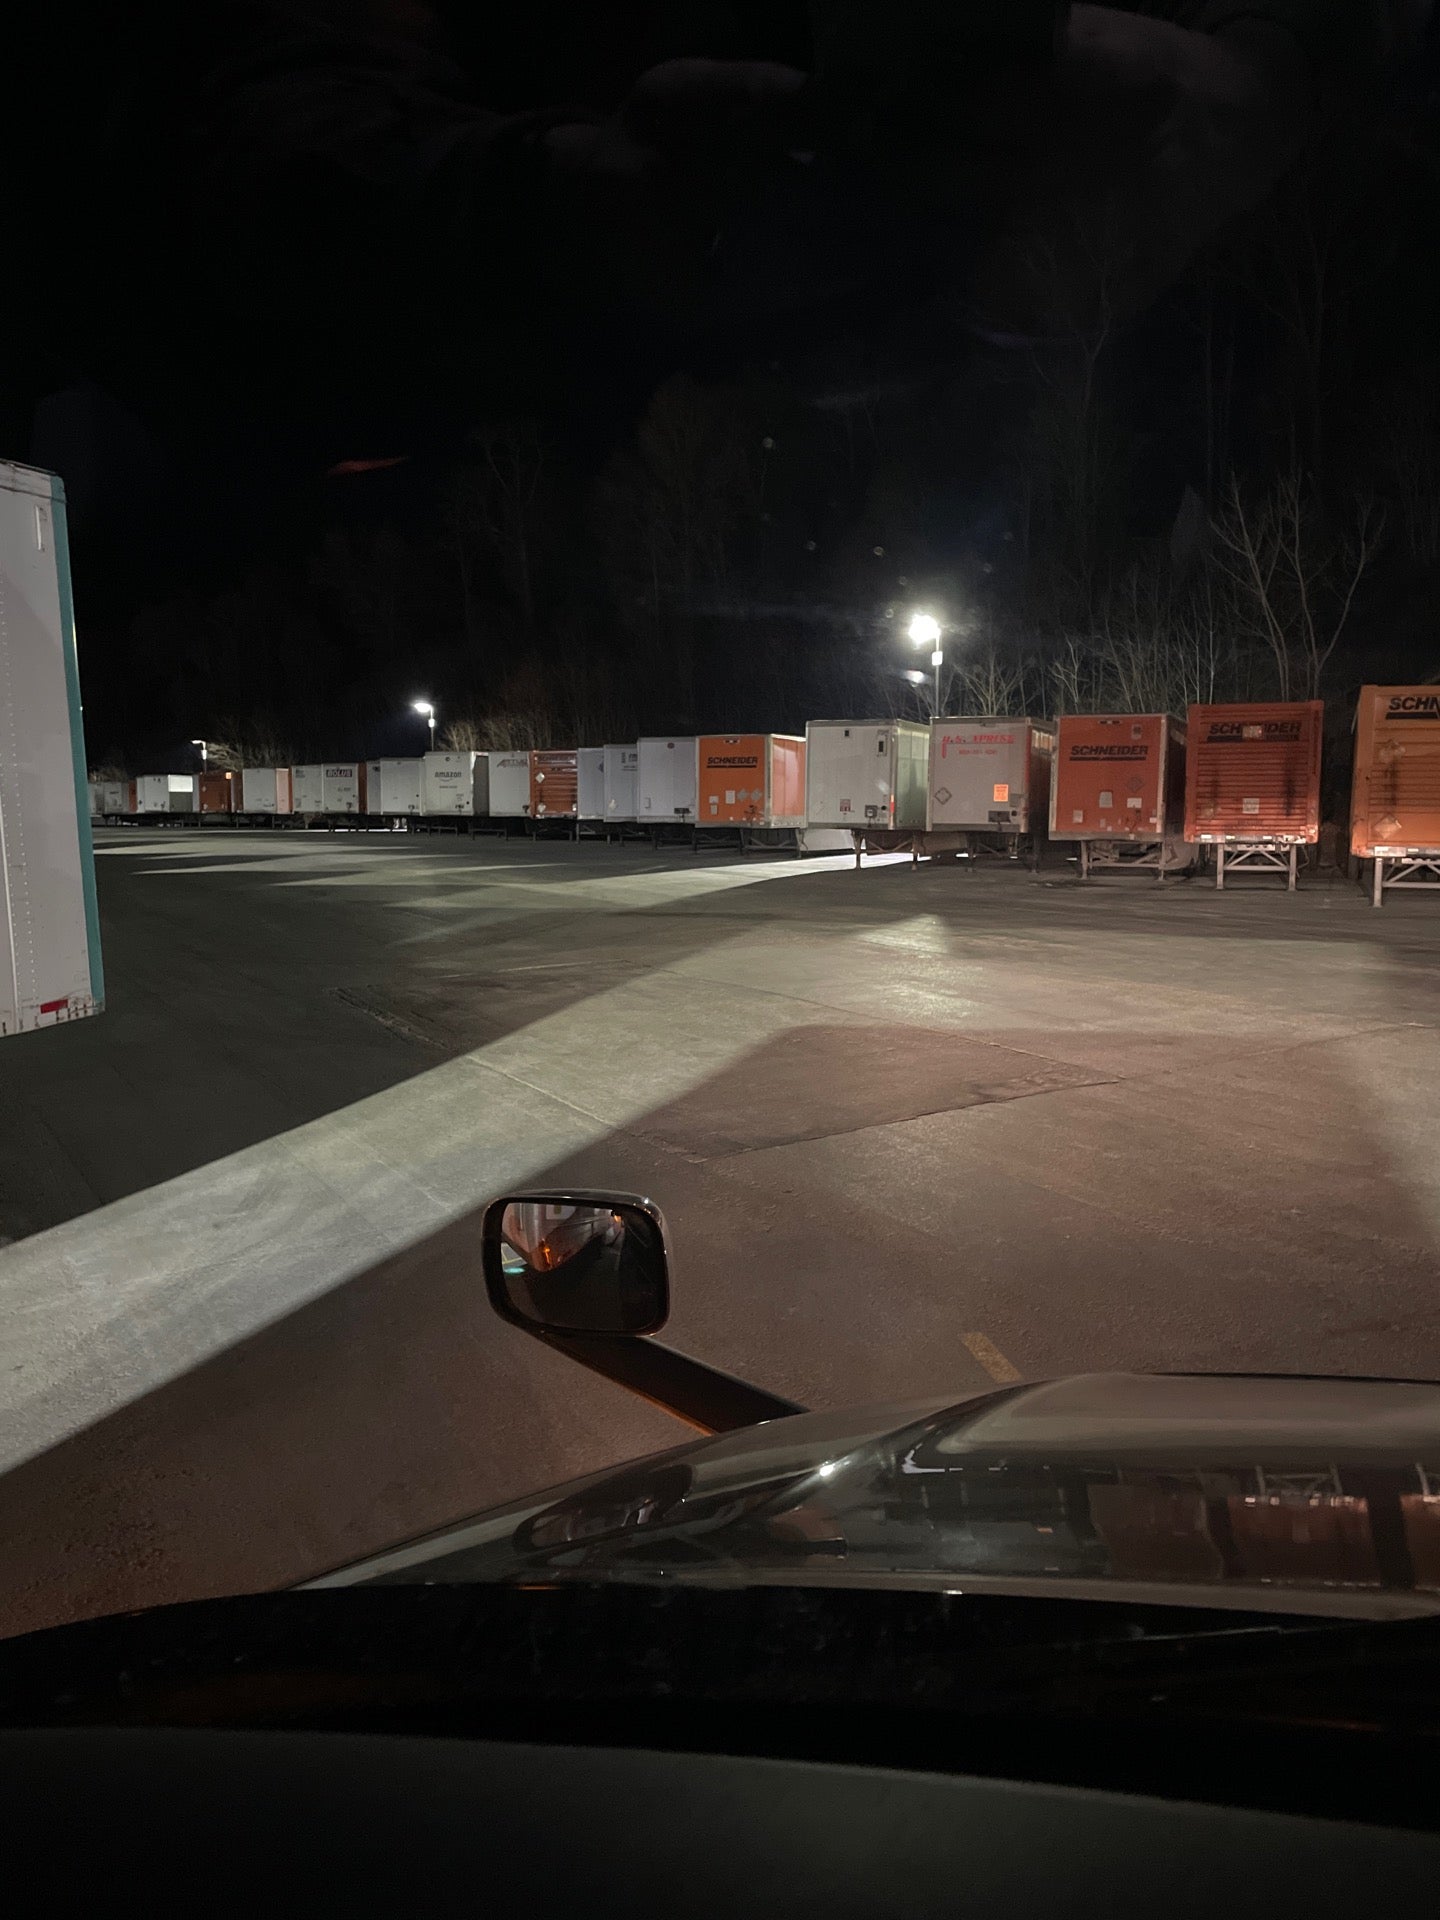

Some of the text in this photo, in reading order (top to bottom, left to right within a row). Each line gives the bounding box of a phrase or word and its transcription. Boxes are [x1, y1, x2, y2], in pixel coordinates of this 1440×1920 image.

[1209, 722, 1301, 735] SCHIDER
[1071, 745, 1148, 756] SCHNEIDER
[707, 756, 758, 765] SCHNEIDER
